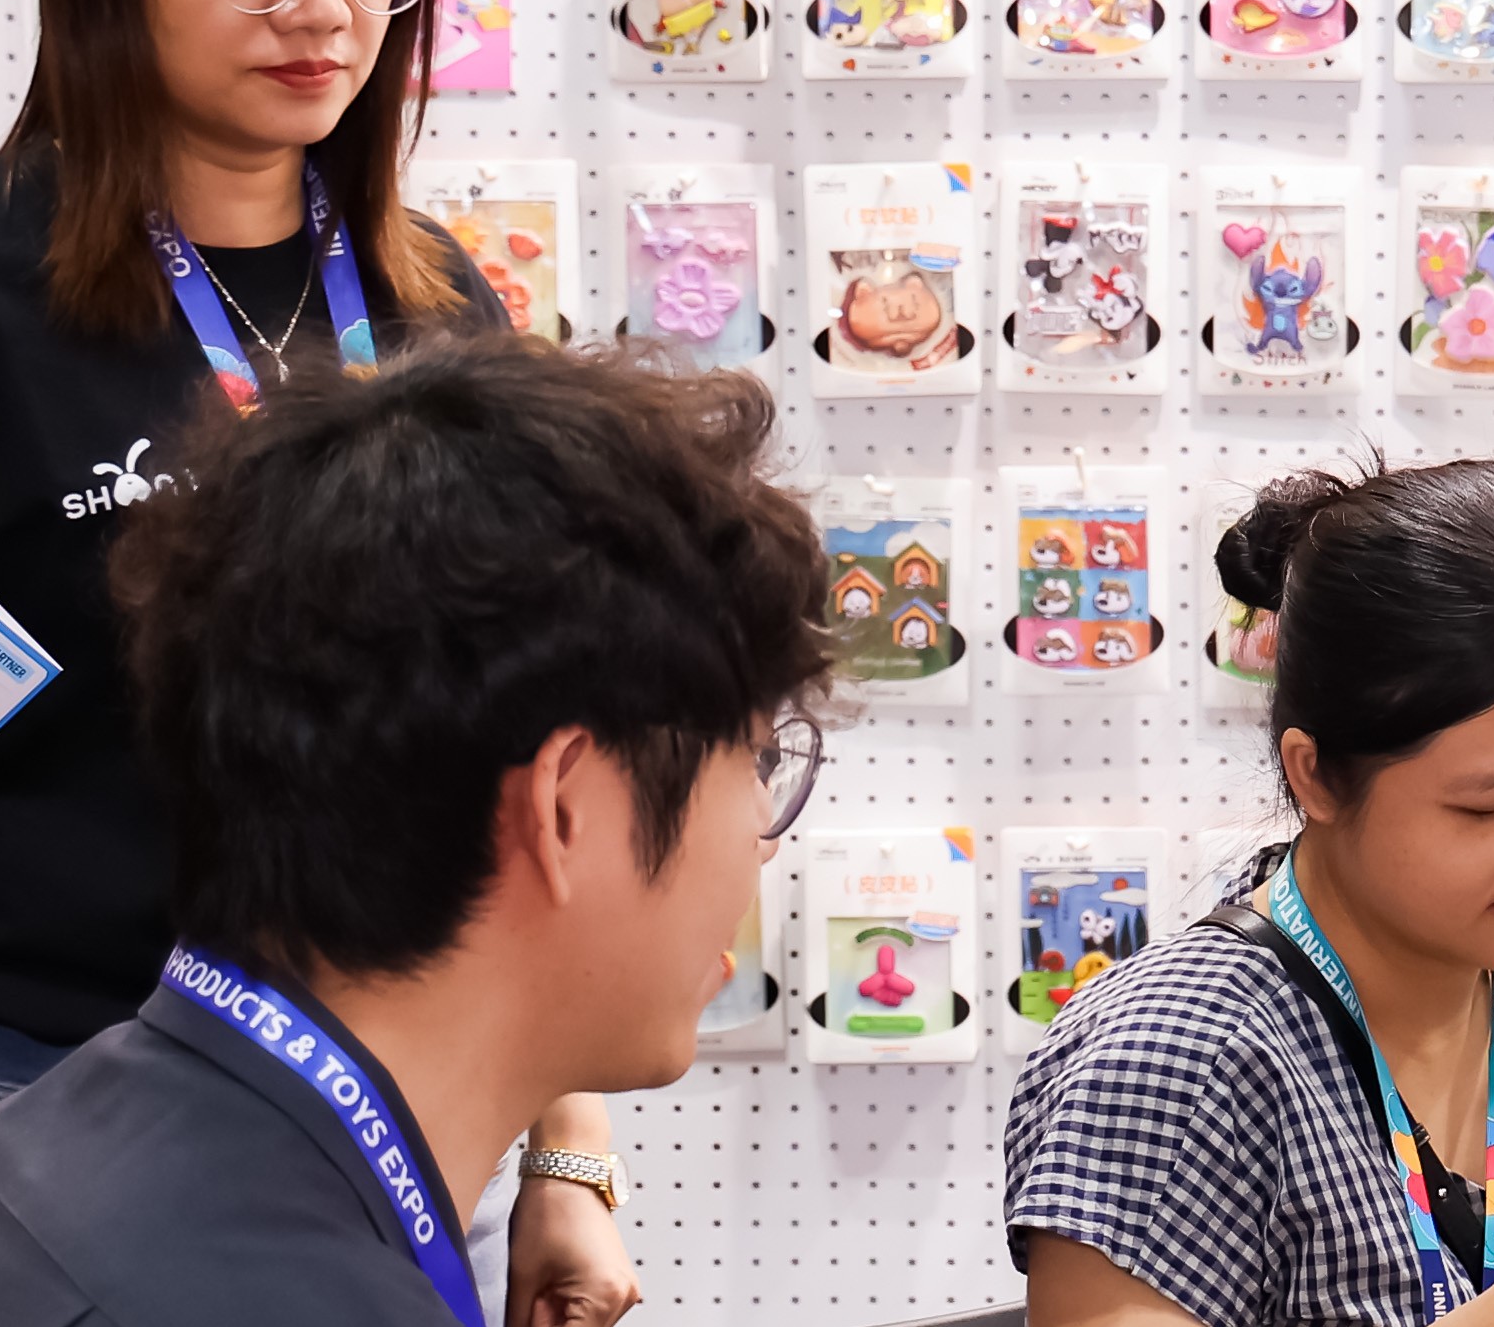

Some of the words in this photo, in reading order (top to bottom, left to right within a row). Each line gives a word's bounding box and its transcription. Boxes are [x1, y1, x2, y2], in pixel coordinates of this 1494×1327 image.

[1273, 863, 1362, 1019] INTERNATION
[285, 1032, 318, 1065] &
[316, 1053, 389, 1149] TOYS
[377, 1144, 436, 1246] EXPO
